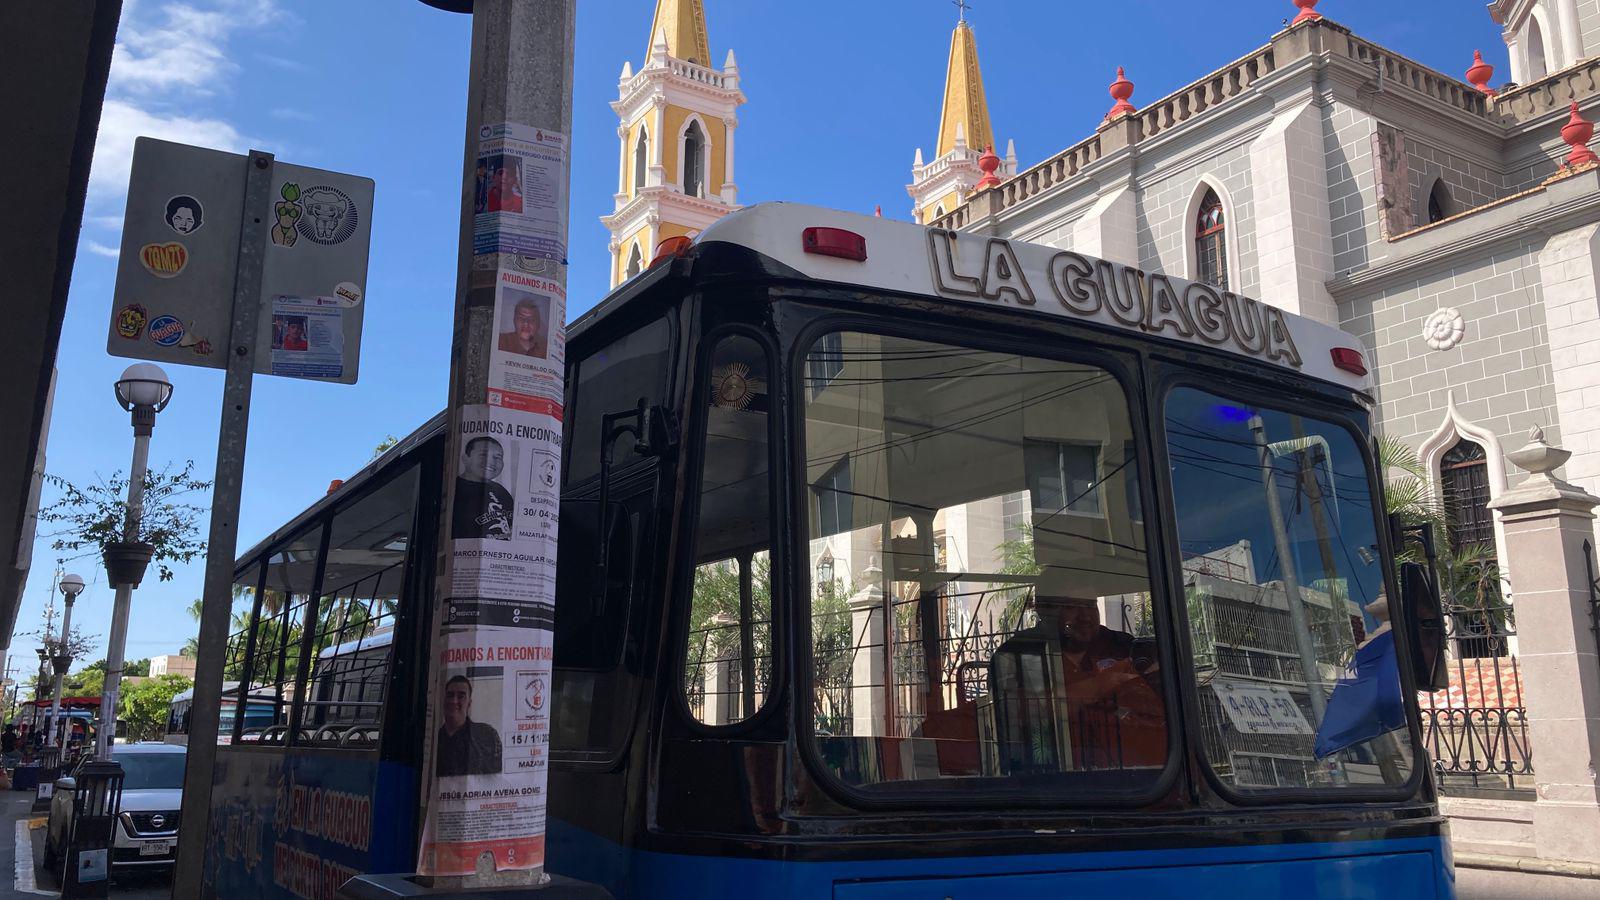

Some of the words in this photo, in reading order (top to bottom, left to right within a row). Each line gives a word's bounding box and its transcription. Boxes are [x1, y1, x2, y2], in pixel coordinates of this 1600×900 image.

[925, 228, 1036, 305] LA
[1048, 251, 1303, 367] GUAGUA
[459, 420, 503, 434] UDANOS
[505, 423, 513, 436] A
[453, 550, 477, 558] MARCO
[479, 551, 512, 560] ERNESTO
[513, 554, 545, 563] AGUILAR
[487, 647, 494, 661] A
[463, 790, 492, 799] ADRIAN
[494, 788, 519, 797] AVENA
[323, 789, 371, 852] GUAGUA
